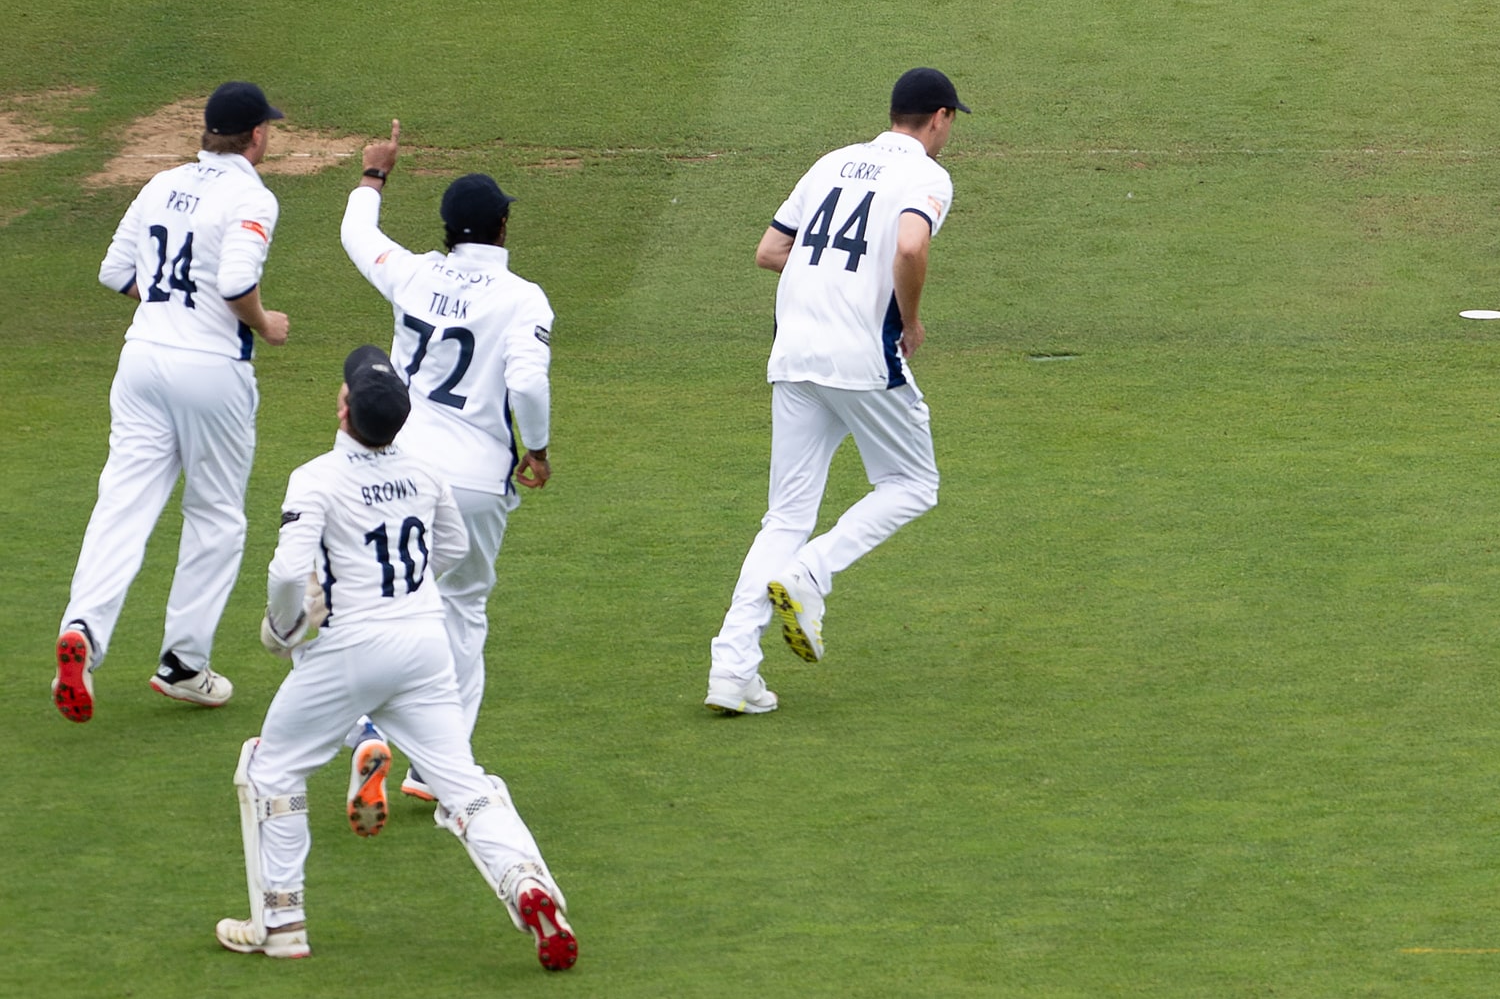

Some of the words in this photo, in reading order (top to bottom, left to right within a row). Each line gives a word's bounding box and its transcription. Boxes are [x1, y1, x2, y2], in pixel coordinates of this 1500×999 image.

[802, 186, 876, 272] 44
[429, 291, 471, 320] TILAK
[403, 313, 475, 410] 72
[362, 477, 418, 506] BROWN
[364, 516, 428, 598] 10
